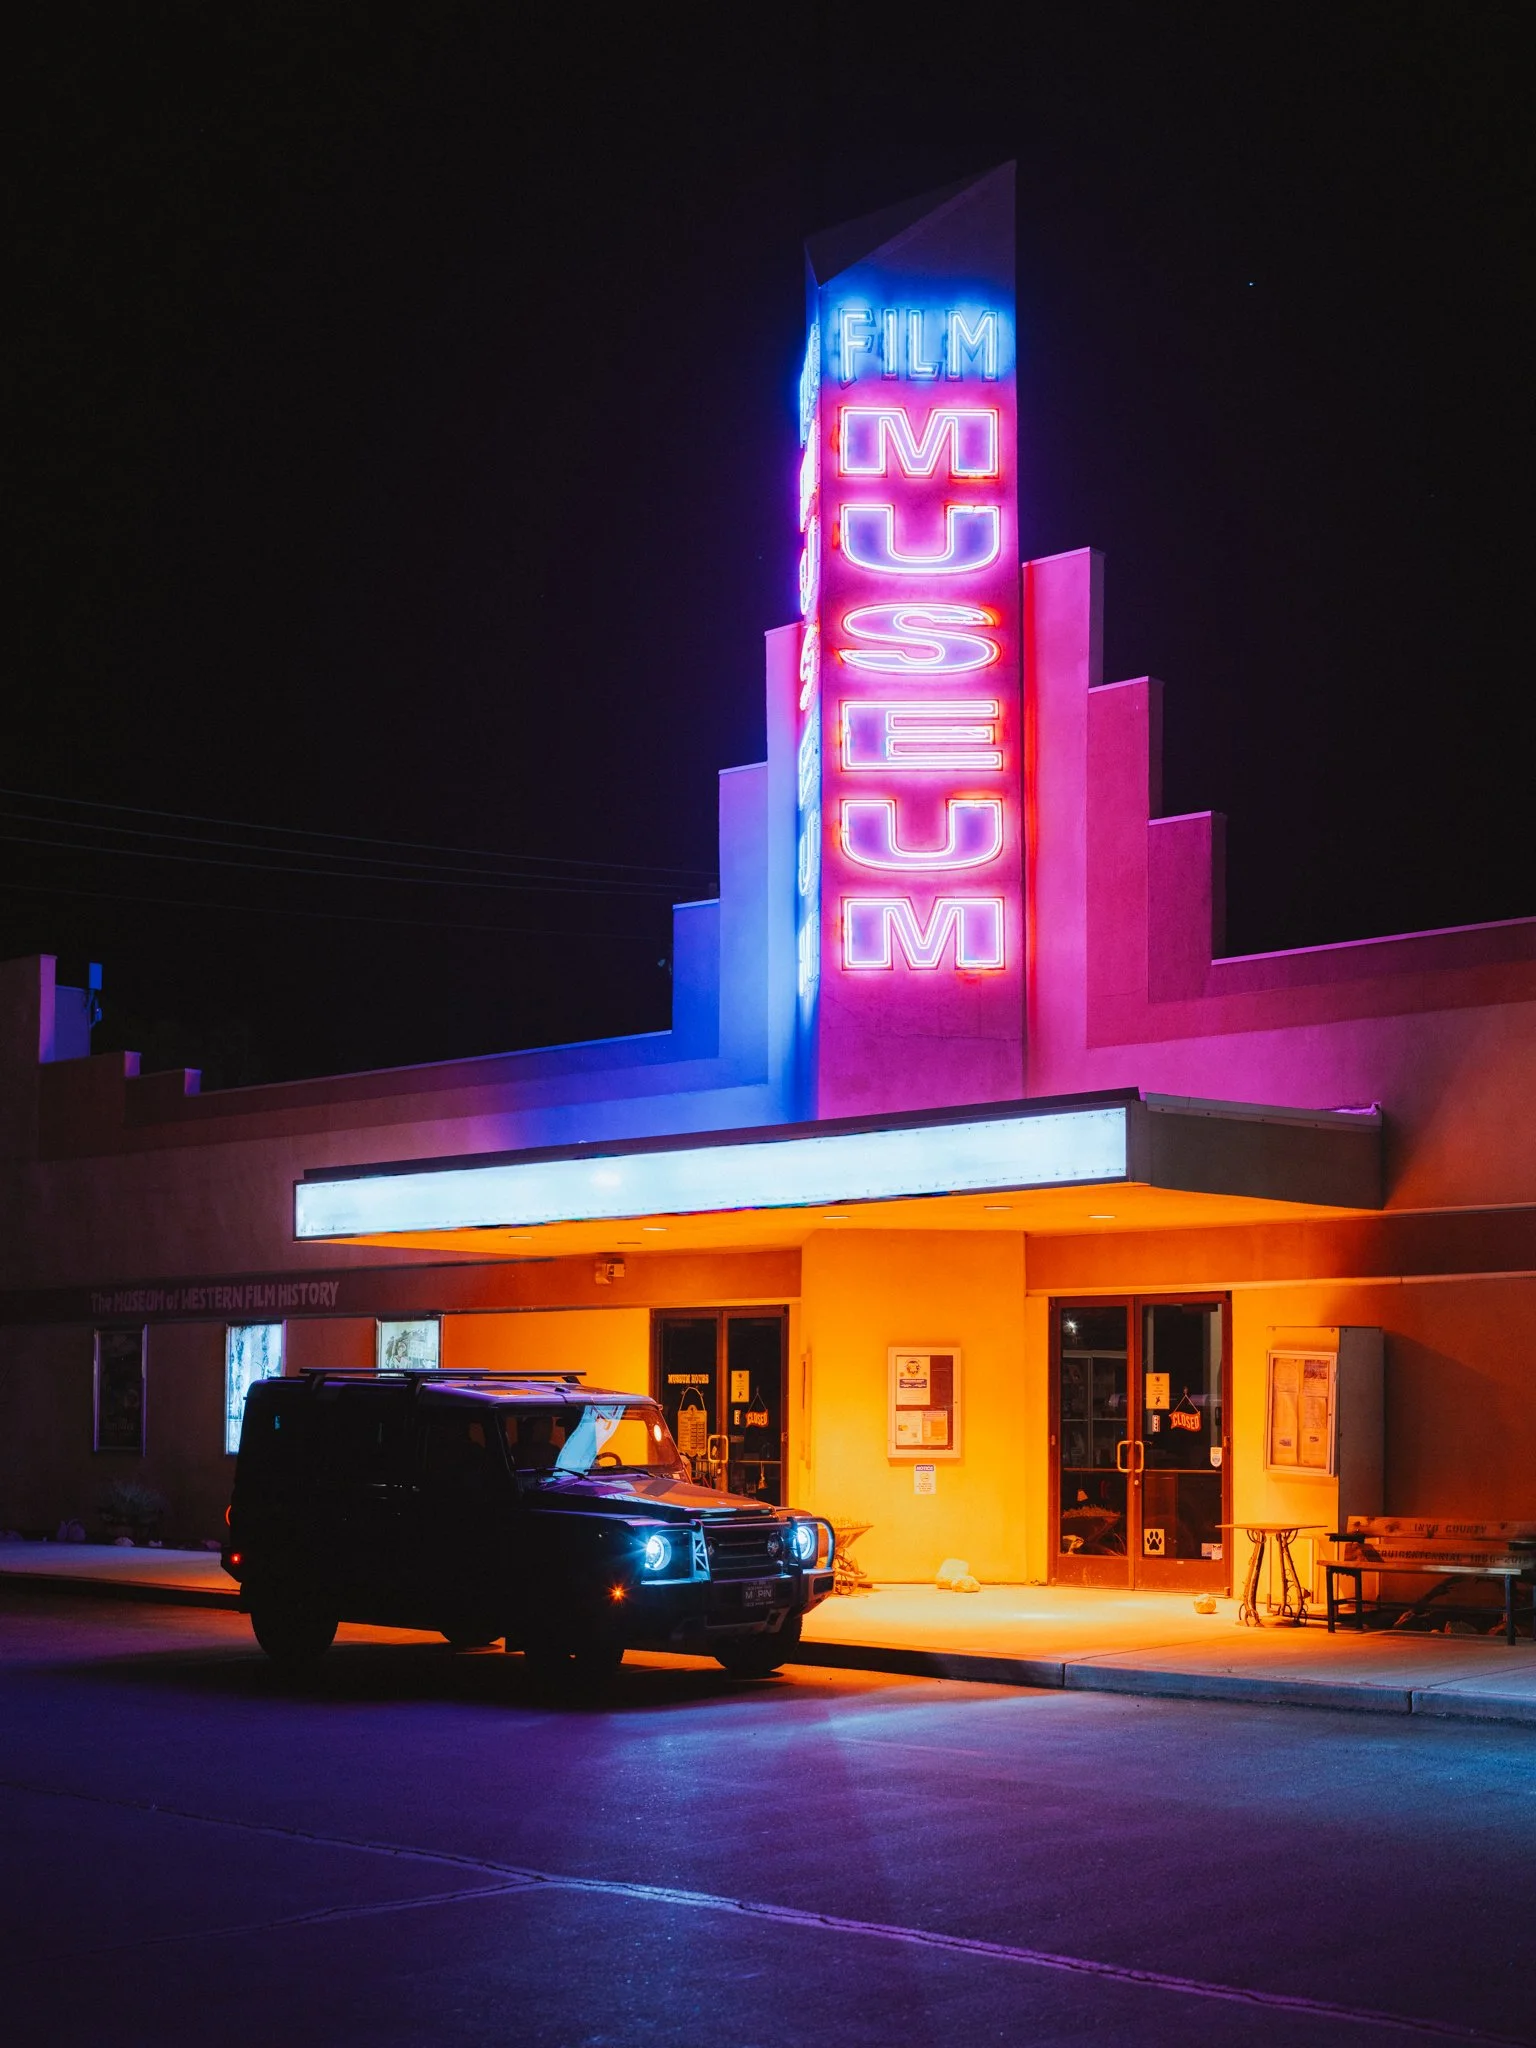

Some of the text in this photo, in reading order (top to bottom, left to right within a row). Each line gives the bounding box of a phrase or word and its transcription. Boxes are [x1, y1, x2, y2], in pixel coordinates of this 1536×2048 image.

[838, 307, 1000, 390] FILM
[838, 407, 1006, 972] MUSEUM
[90, 1281, 340, 1313] The MUSEUM of WESTERN FILM HISTORY
[747, 1411, 768, 1426] CLOSED
[1172, 1413, 1200, 1430] CLOSED
[1445, 1523, 1487, 1534] COUNTY
